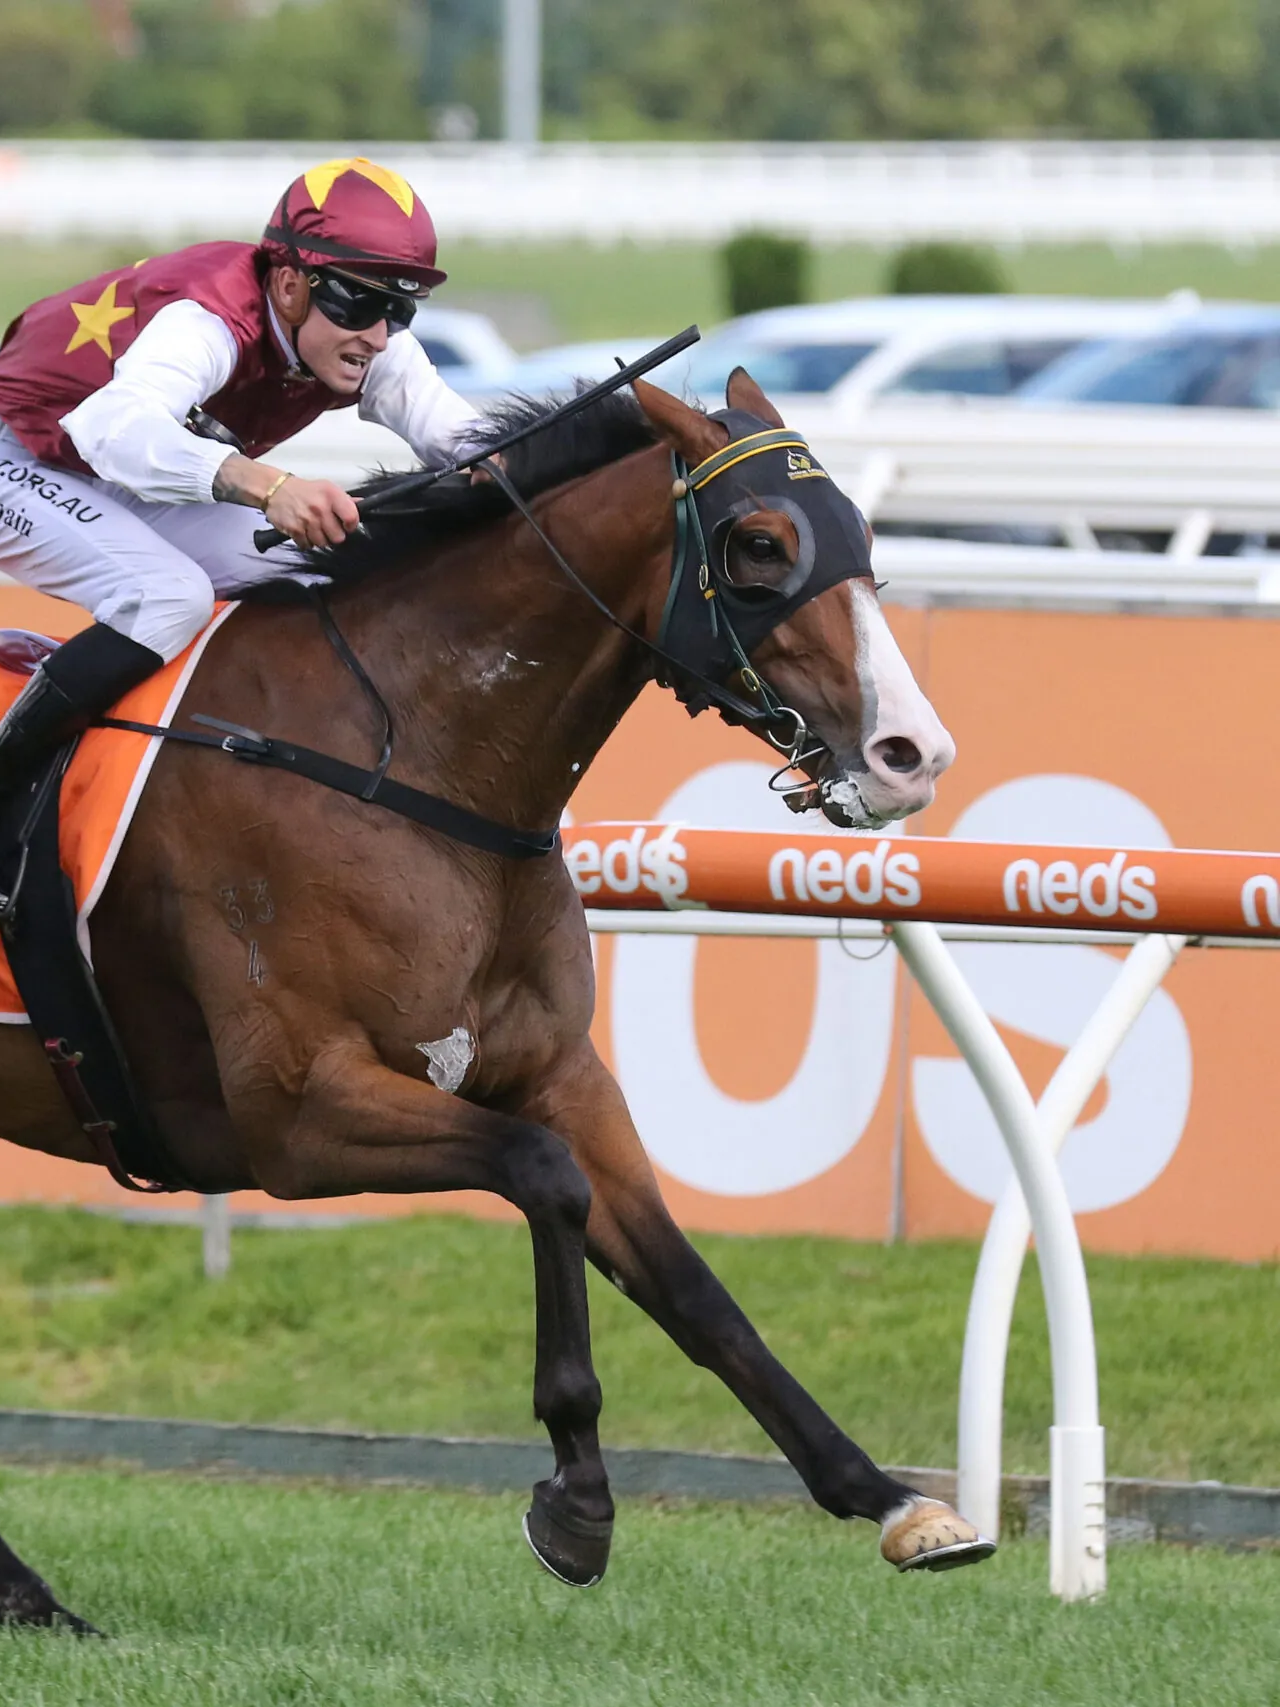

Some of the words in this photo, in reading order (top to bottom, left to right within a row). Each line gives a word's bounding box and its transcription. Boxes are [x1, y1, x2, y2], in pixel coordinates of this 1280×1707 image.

[563, 826, 689, 894] eds
[769, 840, 921, 906] neds
[1004, 852, 1158, 919] neds
